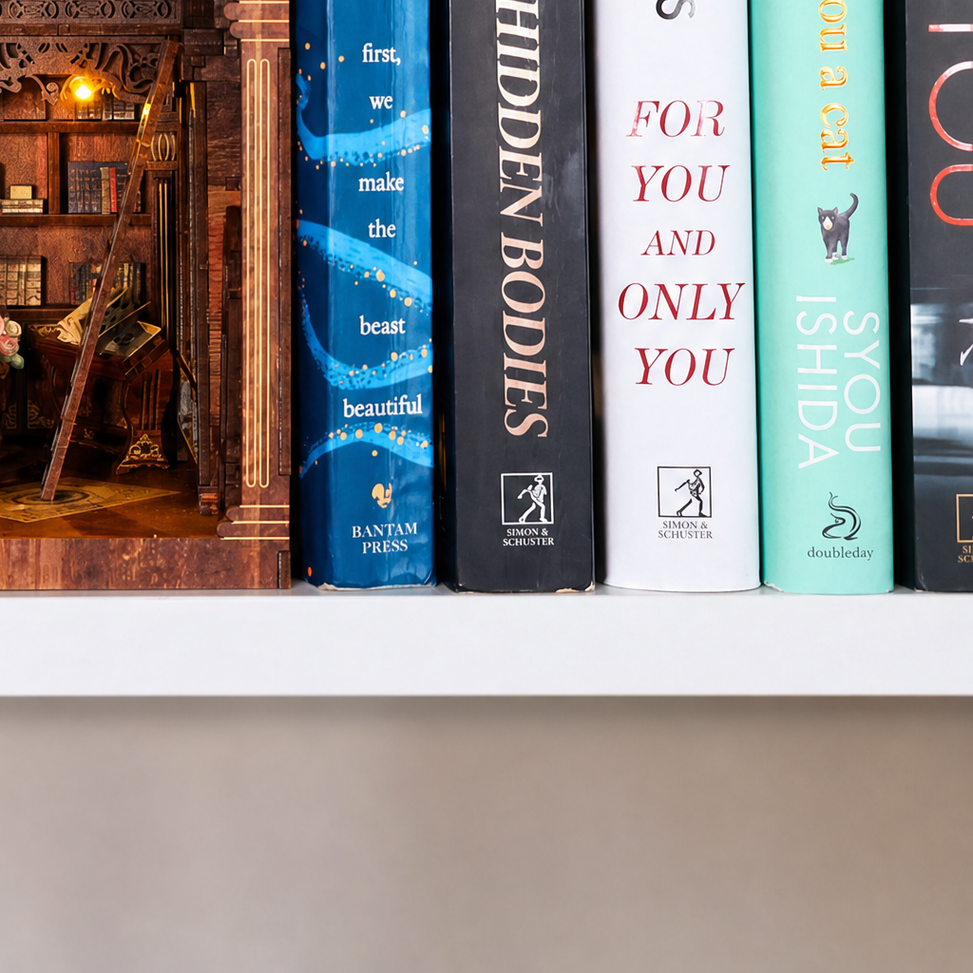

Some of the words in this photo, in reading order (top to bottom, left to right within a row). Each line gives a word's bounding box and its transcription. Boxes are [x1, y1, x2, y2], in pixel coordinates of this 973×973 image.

[362, 43, 401, 65] first,
[819, 65, 848, 92] a
[369, 95, 393, 109] we
[626, 99, 726, 139] FOR
[820, 102, 854, 172] cat
[358, 171, 405, 192] make
[631, 164, 731, 203] YOU
[368, 218, 396, 238] the
[640, 230, 716, 256] AND
[618, 282, 746, 321] ONLY
[359, 315, 406, 335] beast
[500, 231, 549, 438] BODIES
[634, 347, 735, 386] YOU
[795, 295, 840, 469] ISHIDA
[843, 310, 881, 452] SYOU
[342, 394, 423, 418] beautiful
[352, 522, 418, 538] BANTAM
[506, 528, 538, 536] SIMON
[541, 528, 548, 536] &
[658, 530, 713, 539] SCHUSTER
[662, 520, 698, 529] SIMON
[701, 521, 708, 529] &
[362, 539, 408, 554] PRESS
[502, 537, 555, 546] SCHUSTER
[807, 546, 874, 561] doubleday
